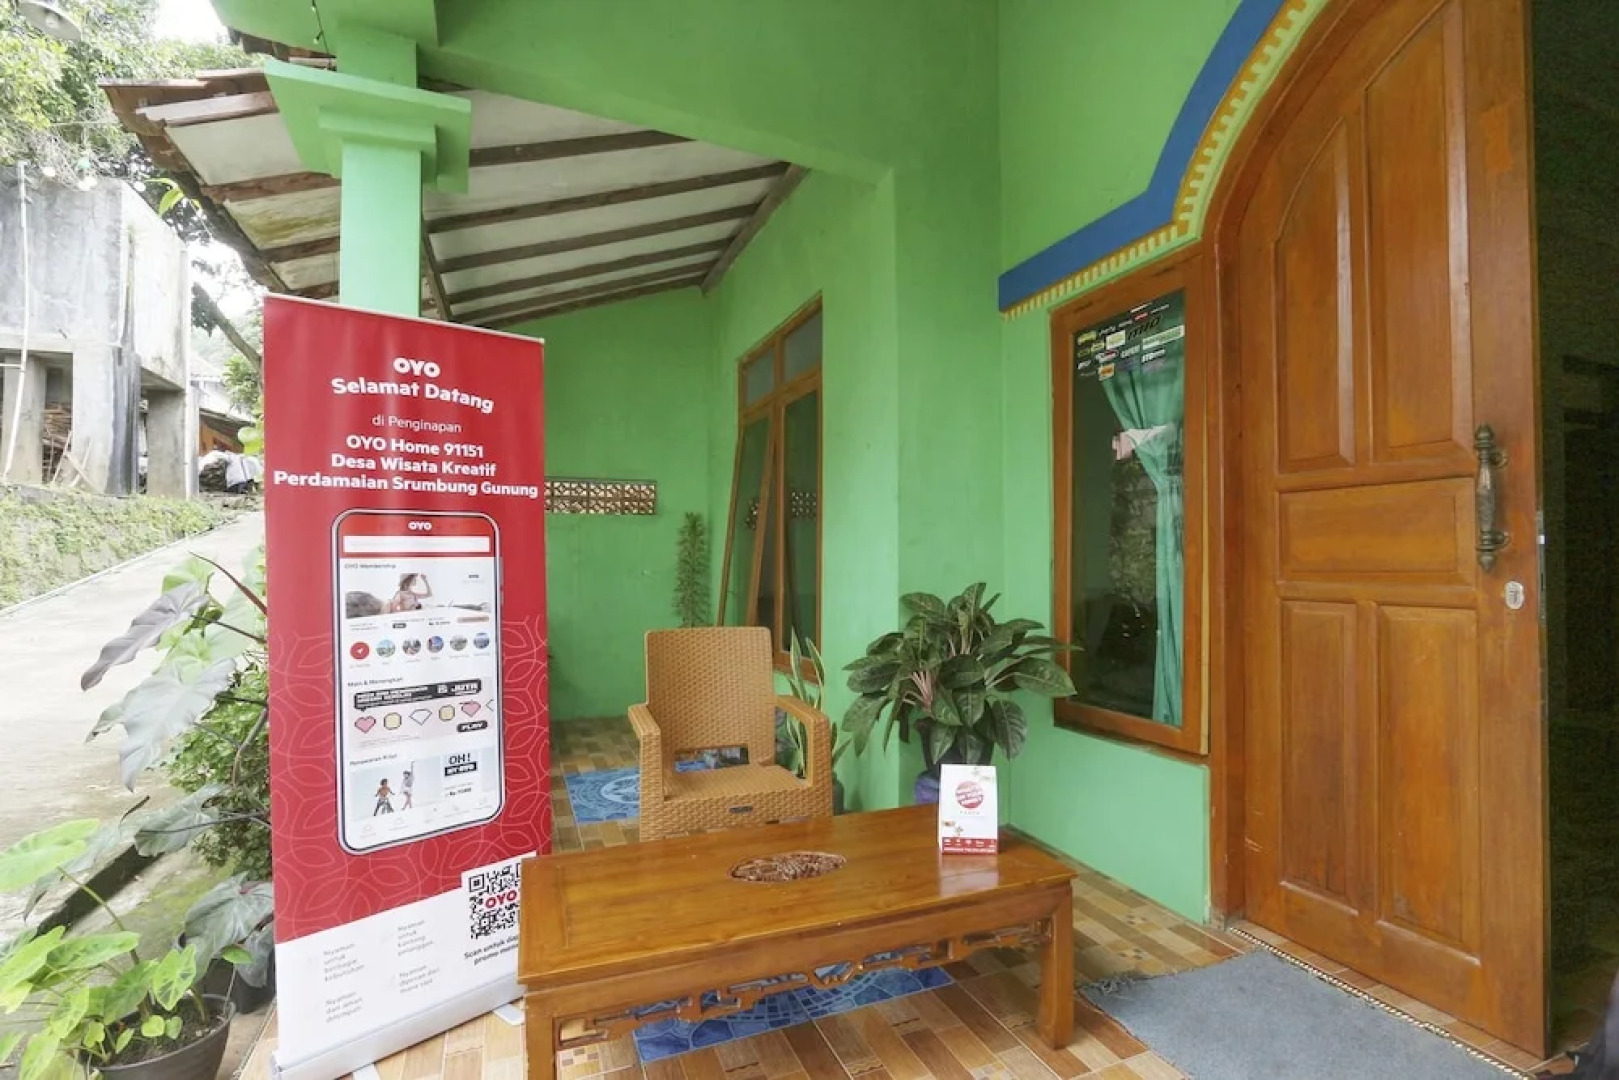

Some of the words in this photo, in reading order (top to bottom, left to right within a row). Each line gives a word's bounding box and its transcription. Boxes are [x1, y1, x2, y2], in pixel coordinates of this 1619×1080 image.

[393, 357, 441, 378] OYO
[331, 378, 420, 396] Selamat
[425, 383, 494, 413] Datang
[372, 415, 385, 427] di
[388, 416, 462, 433] Penginapan
[346, 435, 386, 450] OYO
[391, 438, 440, 455] Home
[444, 443, 483, 457] 91151
[331, 454, 376, 470] Desa
[380, 456, 438, 473] Wisata
[441, 462, 497, 477] Kreatif
[274, 470, 388, 490] Perdamaian
[392, 477, 477, 496] Srumbung
[481, 482, 538, 498] Gunung
[408, 521, 432, 531] OYO
[485, 890, 517, 909] OYO
